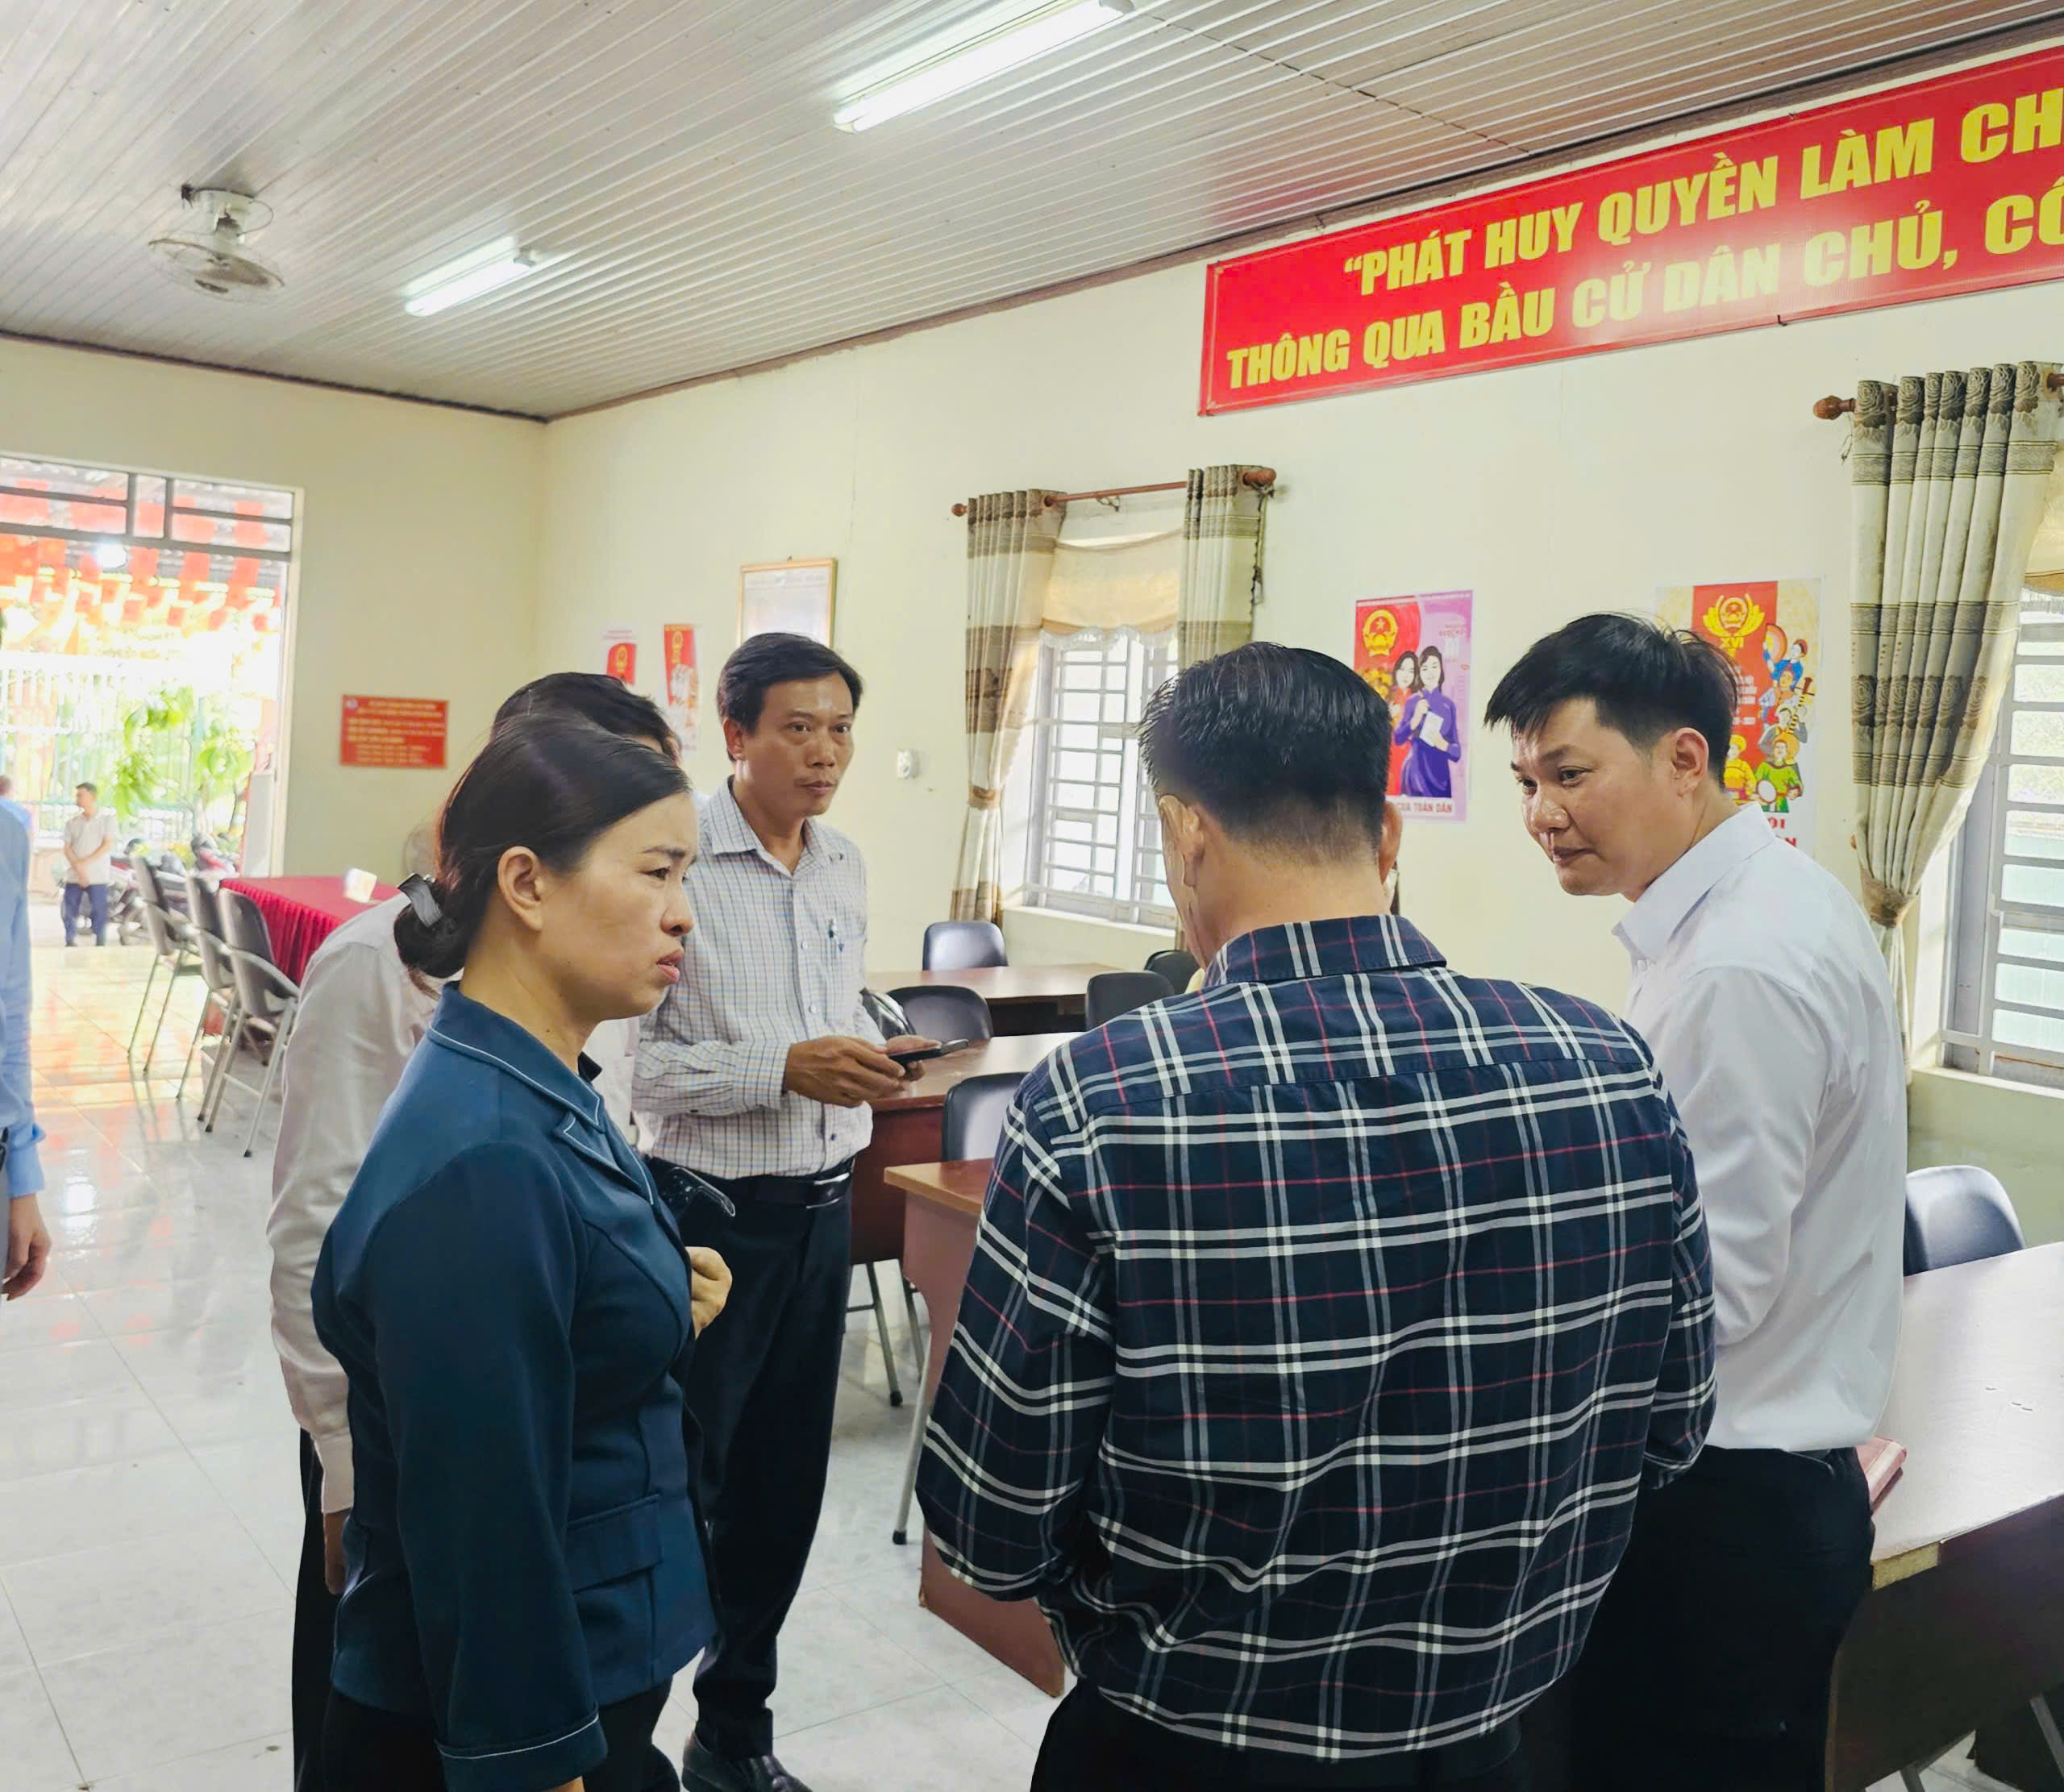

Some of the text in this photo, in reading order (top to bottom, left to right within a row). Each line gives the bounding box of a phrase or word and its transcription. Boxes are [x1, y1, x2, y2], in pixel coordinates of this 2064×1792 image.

[1484, 202, 1583, 269] HUY
[1598, 152, 1778, 246] QUYỀN
[1800, 118, 1934, 200] LÀM
[1226, 334, 1350, 389] THÔNG
[1363, 310, 1446, 368] QUA
[1459, 281, 1555, 349] BẦU
[1571, 260, 1651, 327] CỬ
[1663, 243, 1780, 313] DÂN
[1804, 199, 1958, 287] CHỦ,
